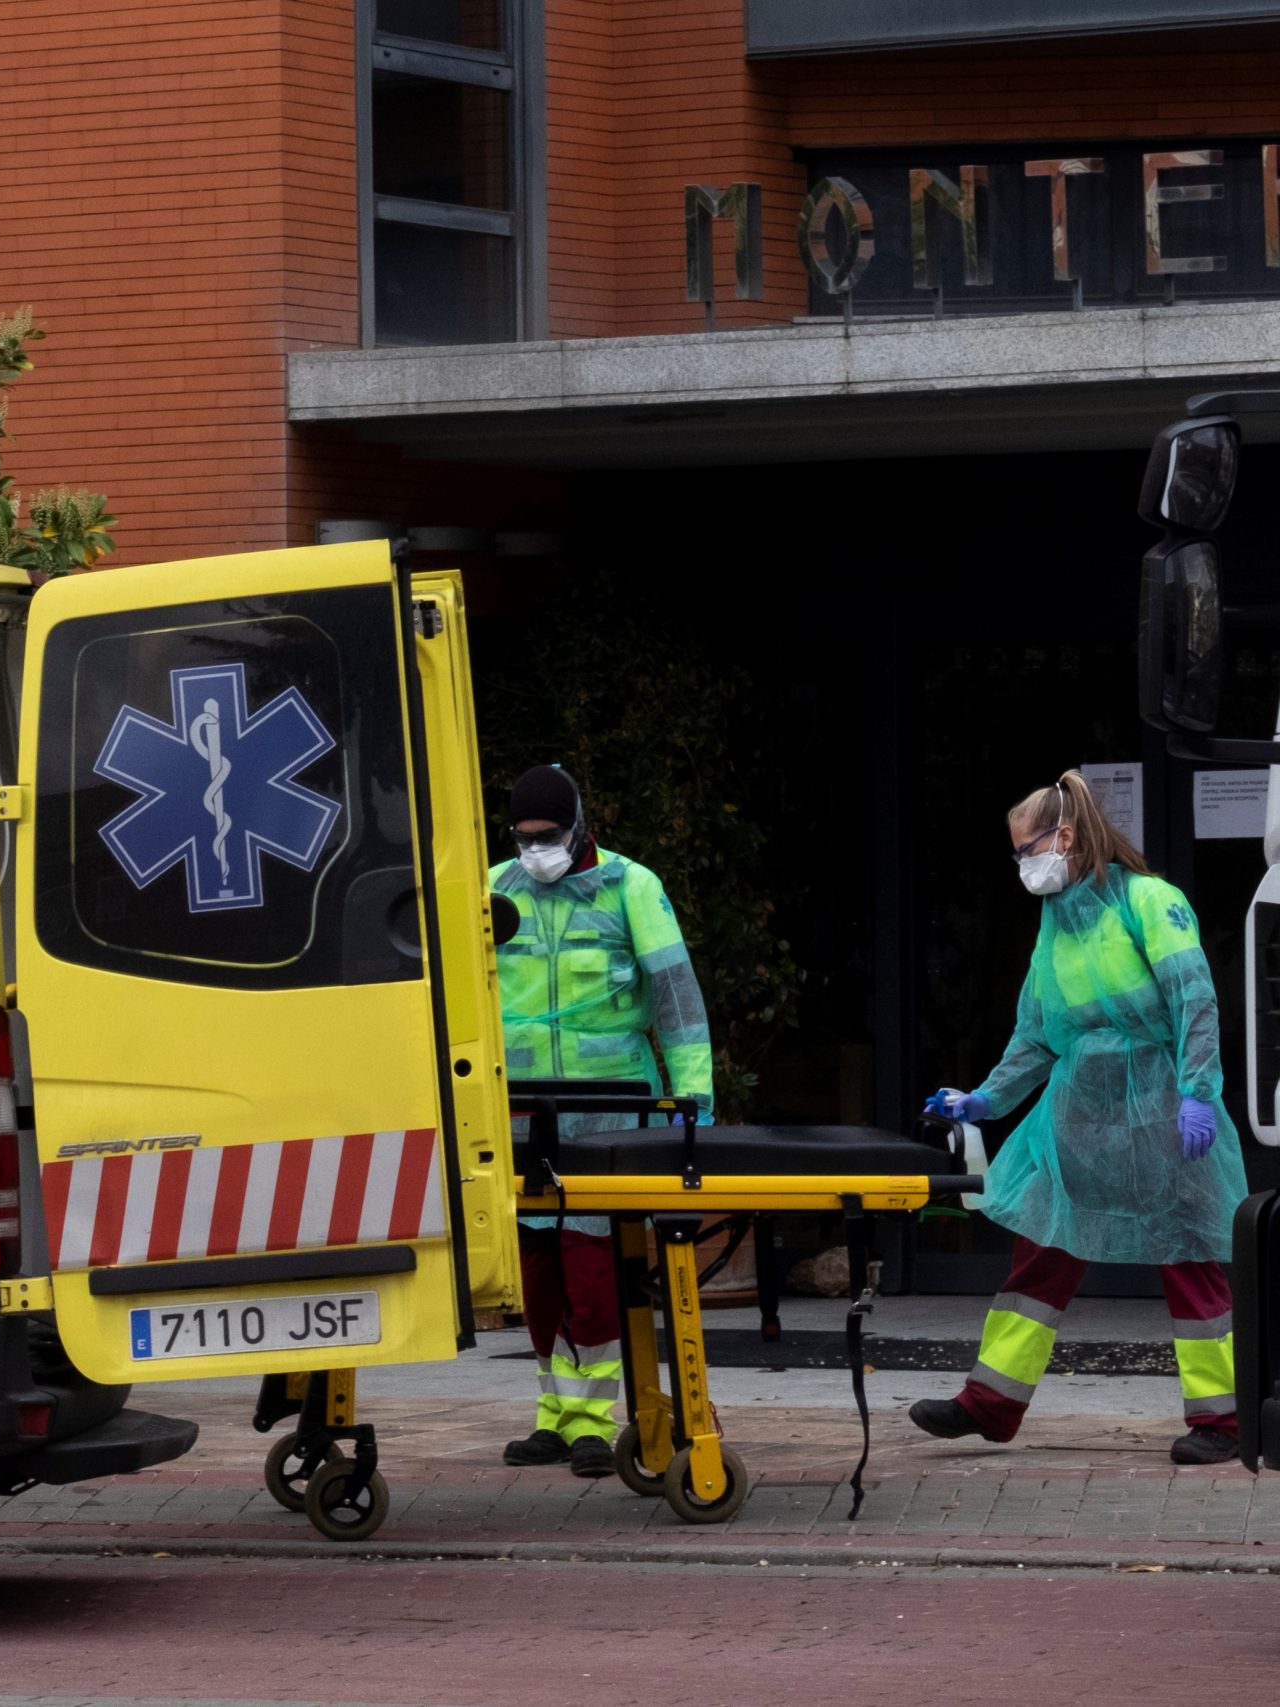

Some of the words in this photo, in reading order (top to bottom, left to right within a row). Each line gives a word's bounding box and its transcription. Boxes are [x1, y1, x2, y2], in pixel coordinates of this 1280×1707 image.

[684, 143, 1280, 301] MONTE
[56, 1134, 201, 1157] SPRINTER
[136, 1338, 147, 1351] E
[161, 1306, 265, 1353] 7110
[288, 1299, 364, 1342] JSF
